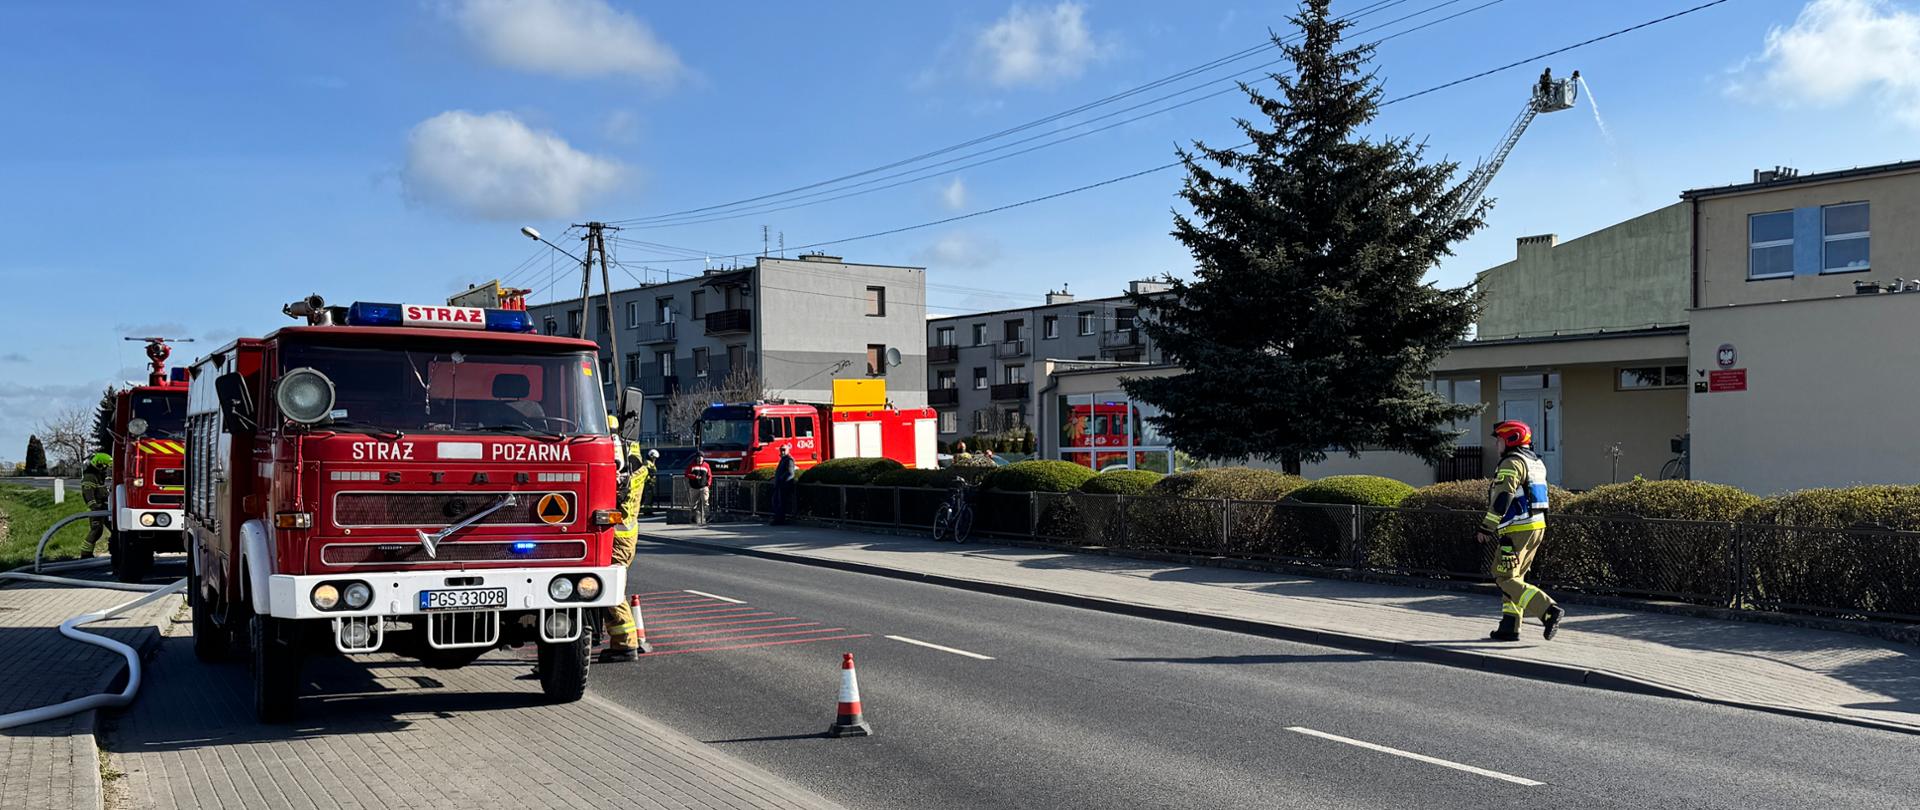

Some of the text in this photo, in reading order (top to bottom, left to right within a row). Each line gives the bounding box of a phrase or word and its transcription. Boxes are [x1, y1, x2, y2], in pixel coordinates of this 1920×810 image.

[492, 443, 571, 461] POŻARNA
[384, 471, 530, 485] STAR
[429, 590, 504, 607] PGS 33098
